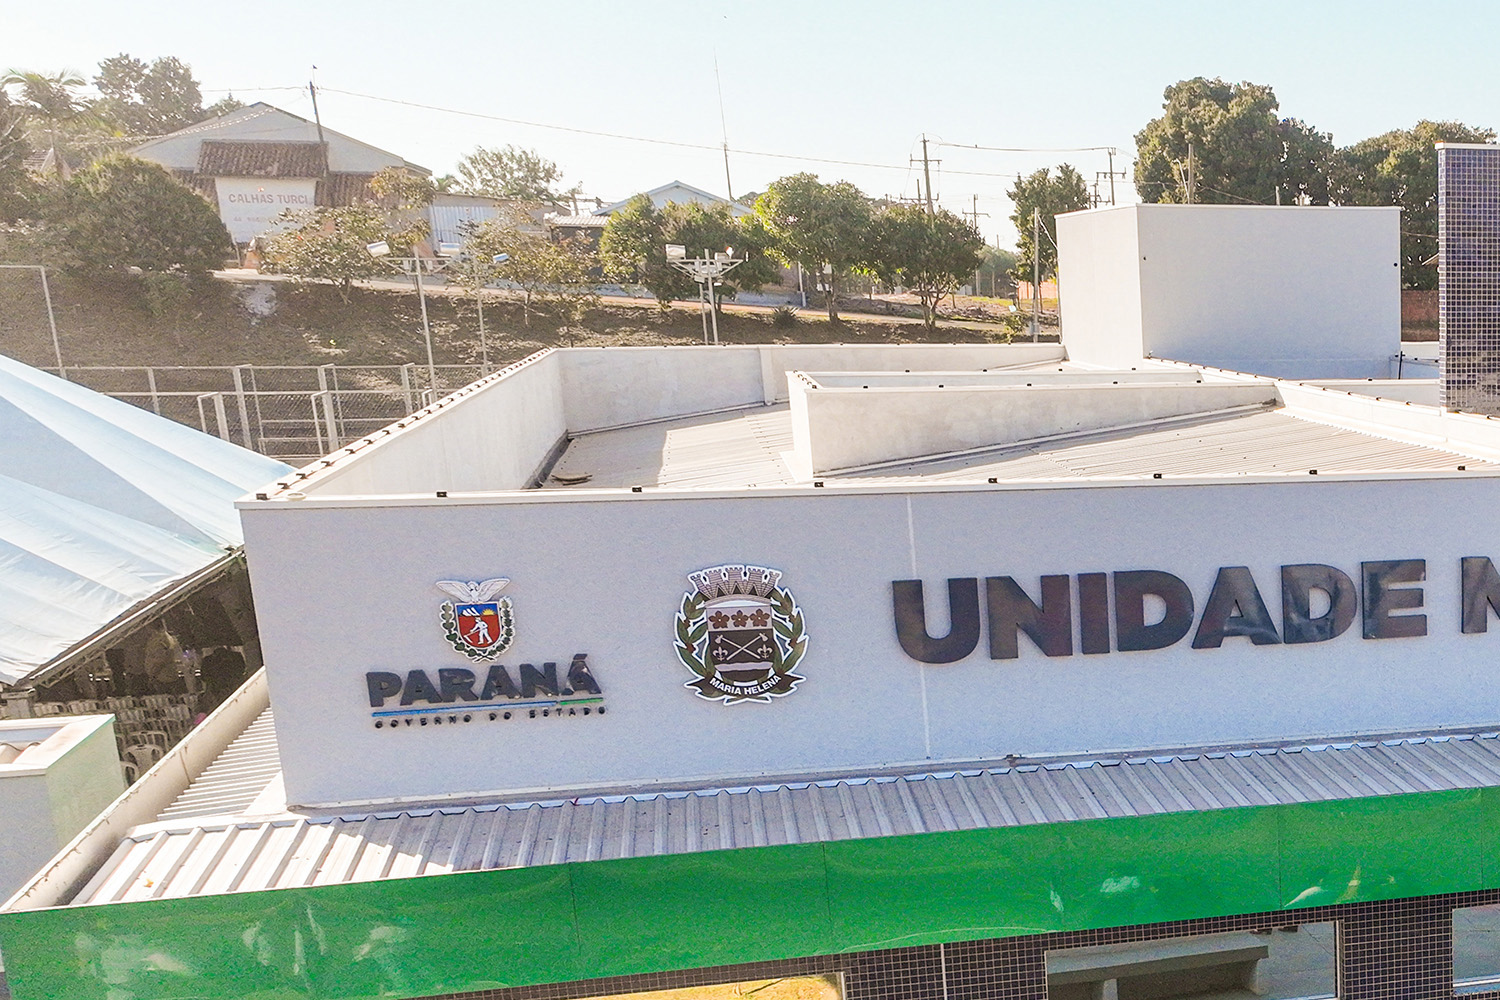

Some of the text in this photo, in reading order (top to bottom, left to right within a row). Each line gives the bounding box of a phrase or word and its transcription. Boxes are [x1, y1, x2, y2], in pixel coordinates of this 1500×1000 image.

[228, 193, 308, 204] CALHAS TURCI
[892, 558, 1428, 664] UNIDADE
[365, 653, 602, 707] PARANÁ
[709, 675, 782, 695] MARIA HELENA
[374, 706, 606, 729] GOVERNO DO ESTADO
